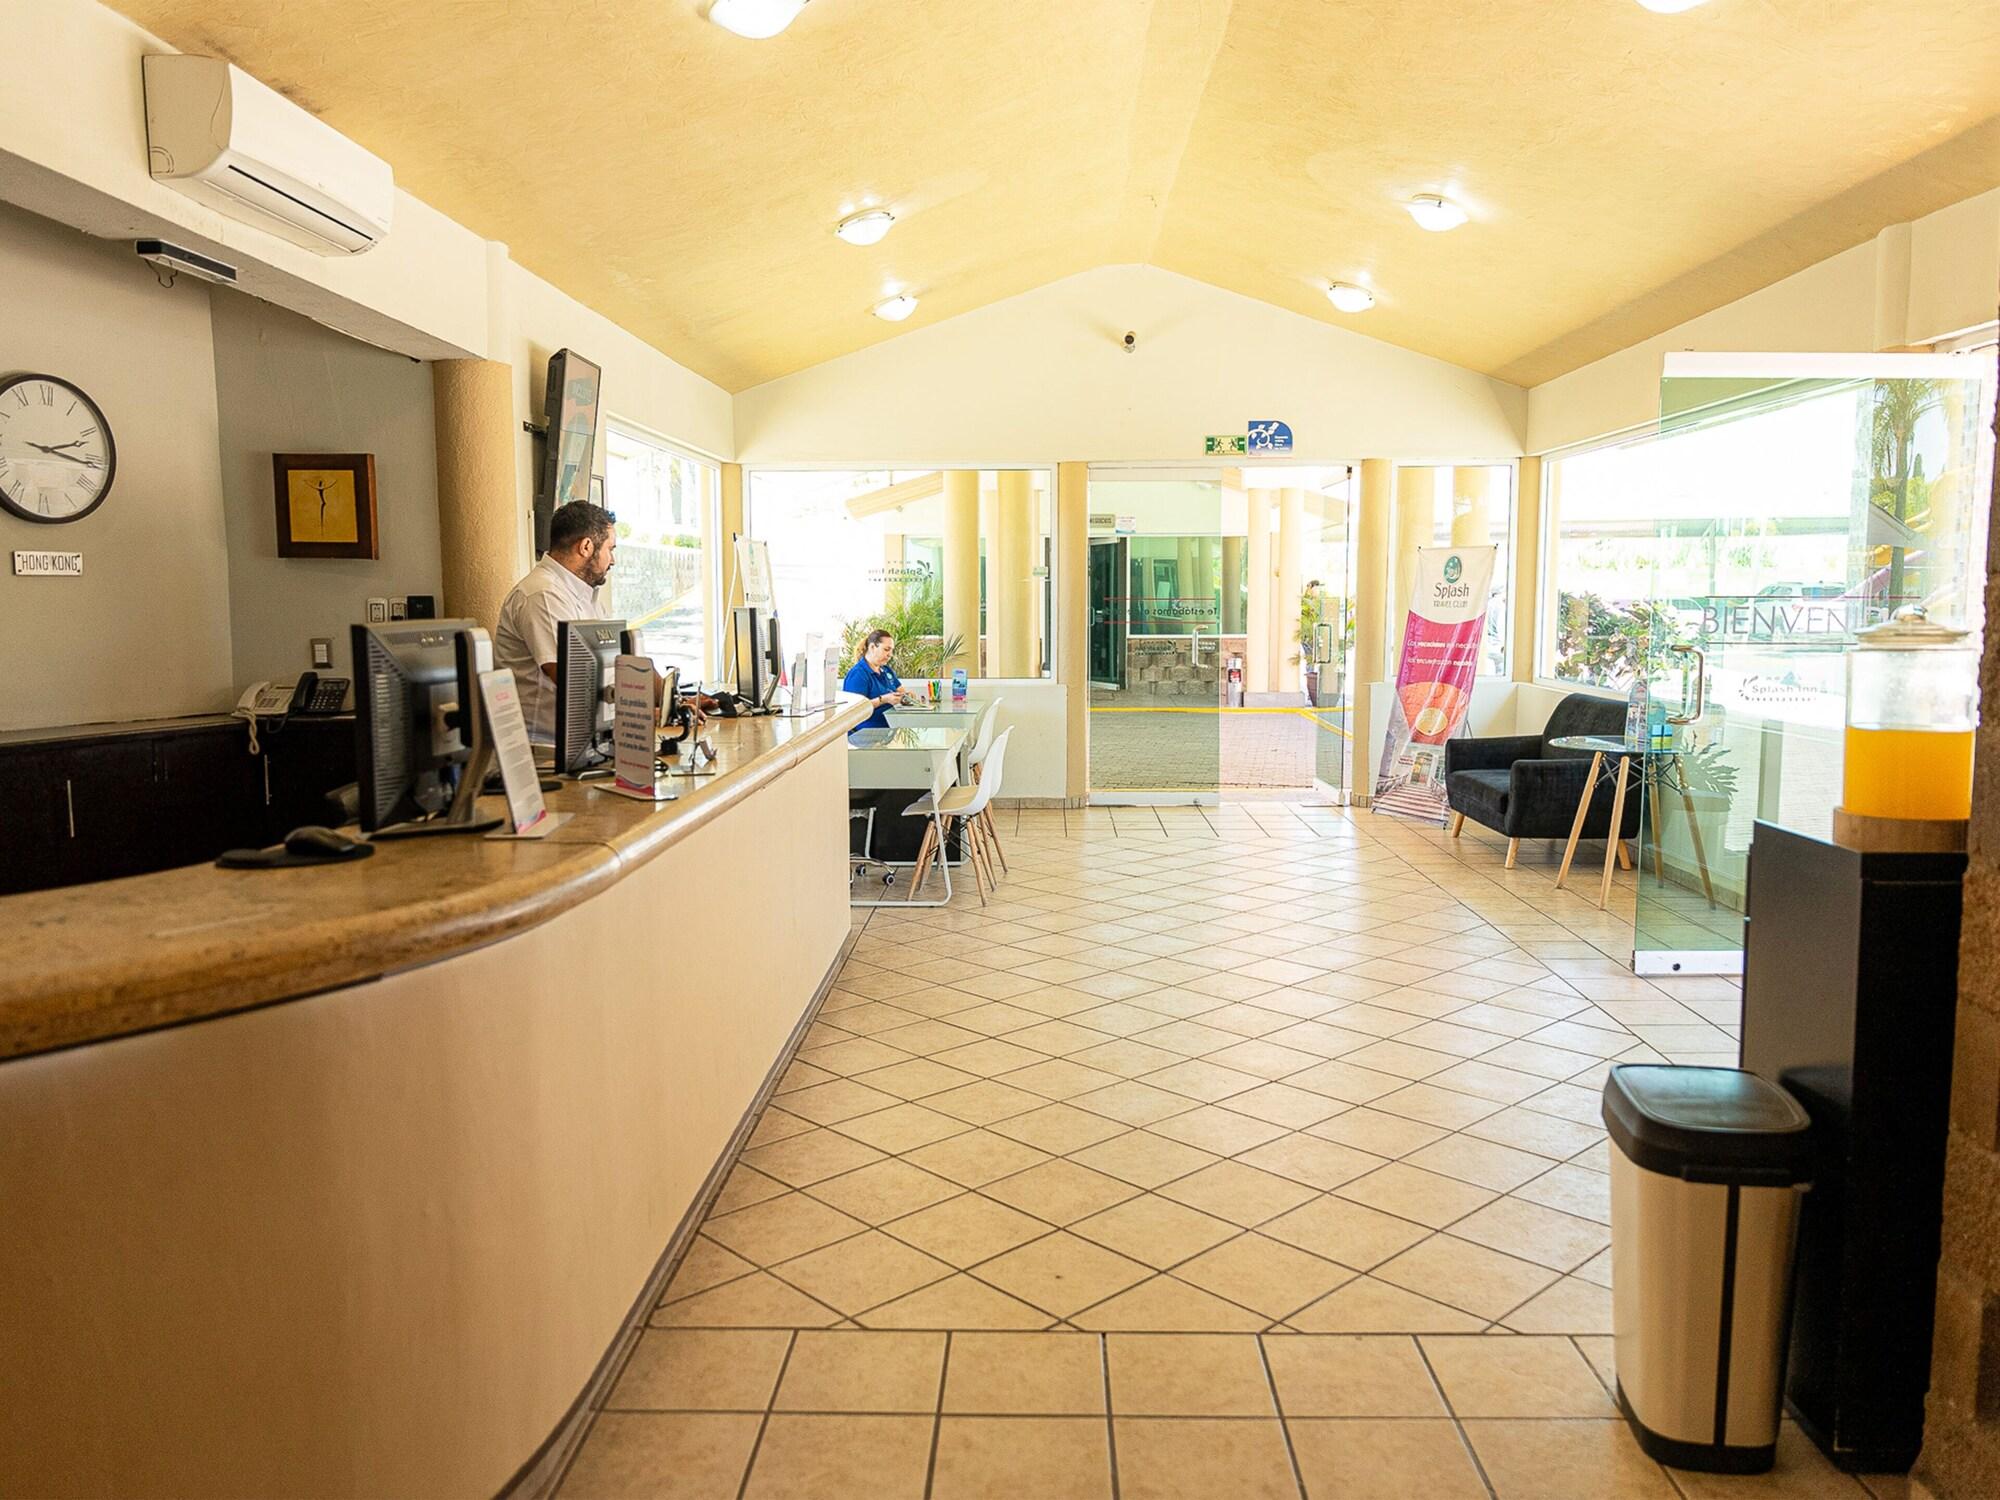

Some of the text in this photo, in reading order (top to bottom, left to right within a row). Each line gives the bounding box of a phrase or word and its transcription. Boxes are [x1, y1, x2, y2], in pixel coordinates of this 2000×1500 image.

[22, 554, 78, 571] HONG KONG
[1433, 582, 1470, 599] Splash
[1751, 684, 1794, 695] Splash
